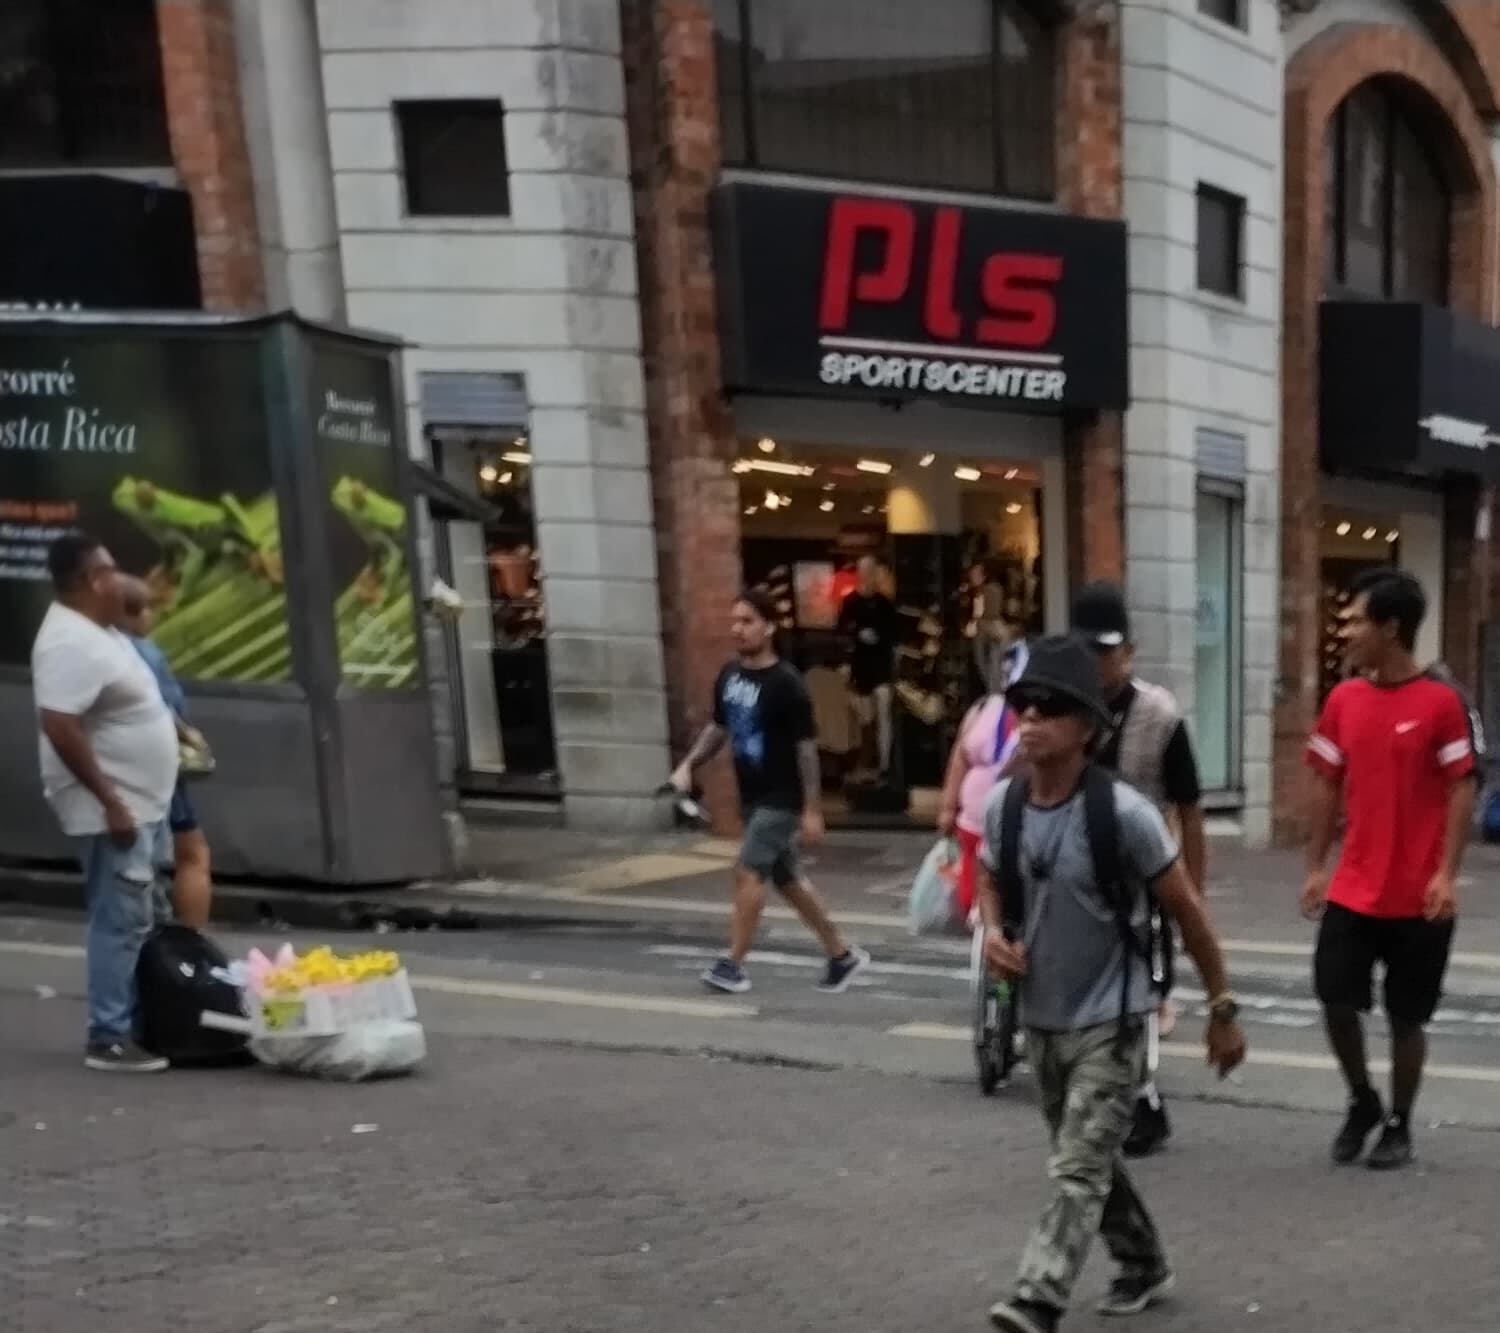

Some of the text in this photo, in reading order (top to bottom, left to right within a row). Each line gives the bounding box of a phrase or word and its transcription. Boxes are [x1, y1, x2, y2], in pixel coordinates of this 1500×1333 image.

[817, 197, 1065, 348] Pls
[0, 357, 77, 396] corré
[819, 352, 1067, 401] SPORTSCENTER
[62, 406, 137, 454] Rica
